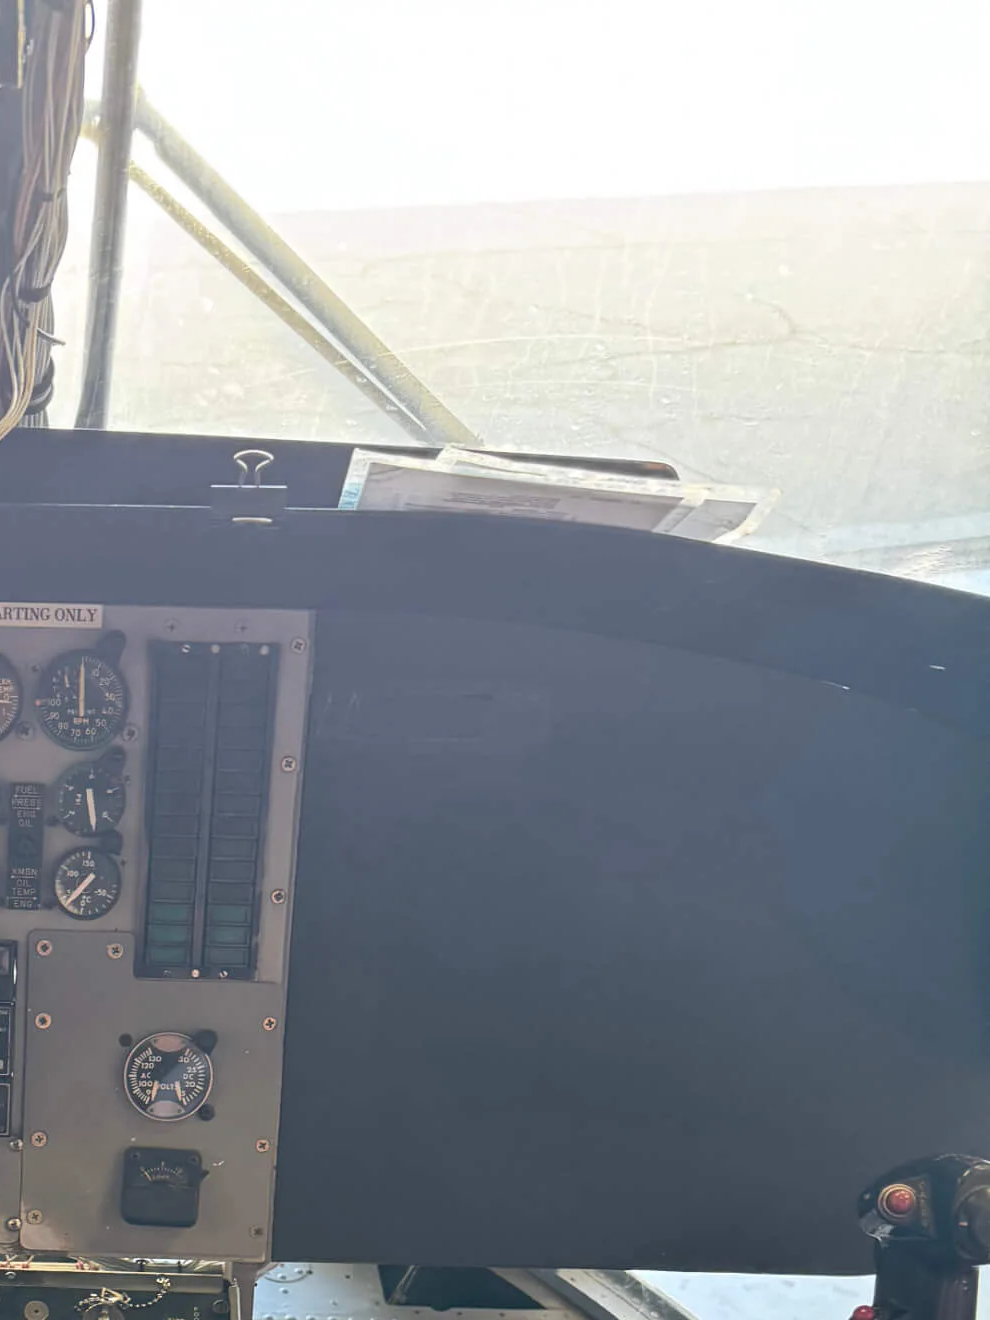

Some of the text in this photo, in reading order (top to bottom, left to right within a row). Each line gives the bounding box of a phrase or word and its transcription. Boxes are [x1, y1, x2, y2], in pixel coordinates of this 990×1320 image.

[54, 608, 98, 622] ONLY
[15, 785, 38, 794] FUEL
[12, 888, 36, 896] TEMP
